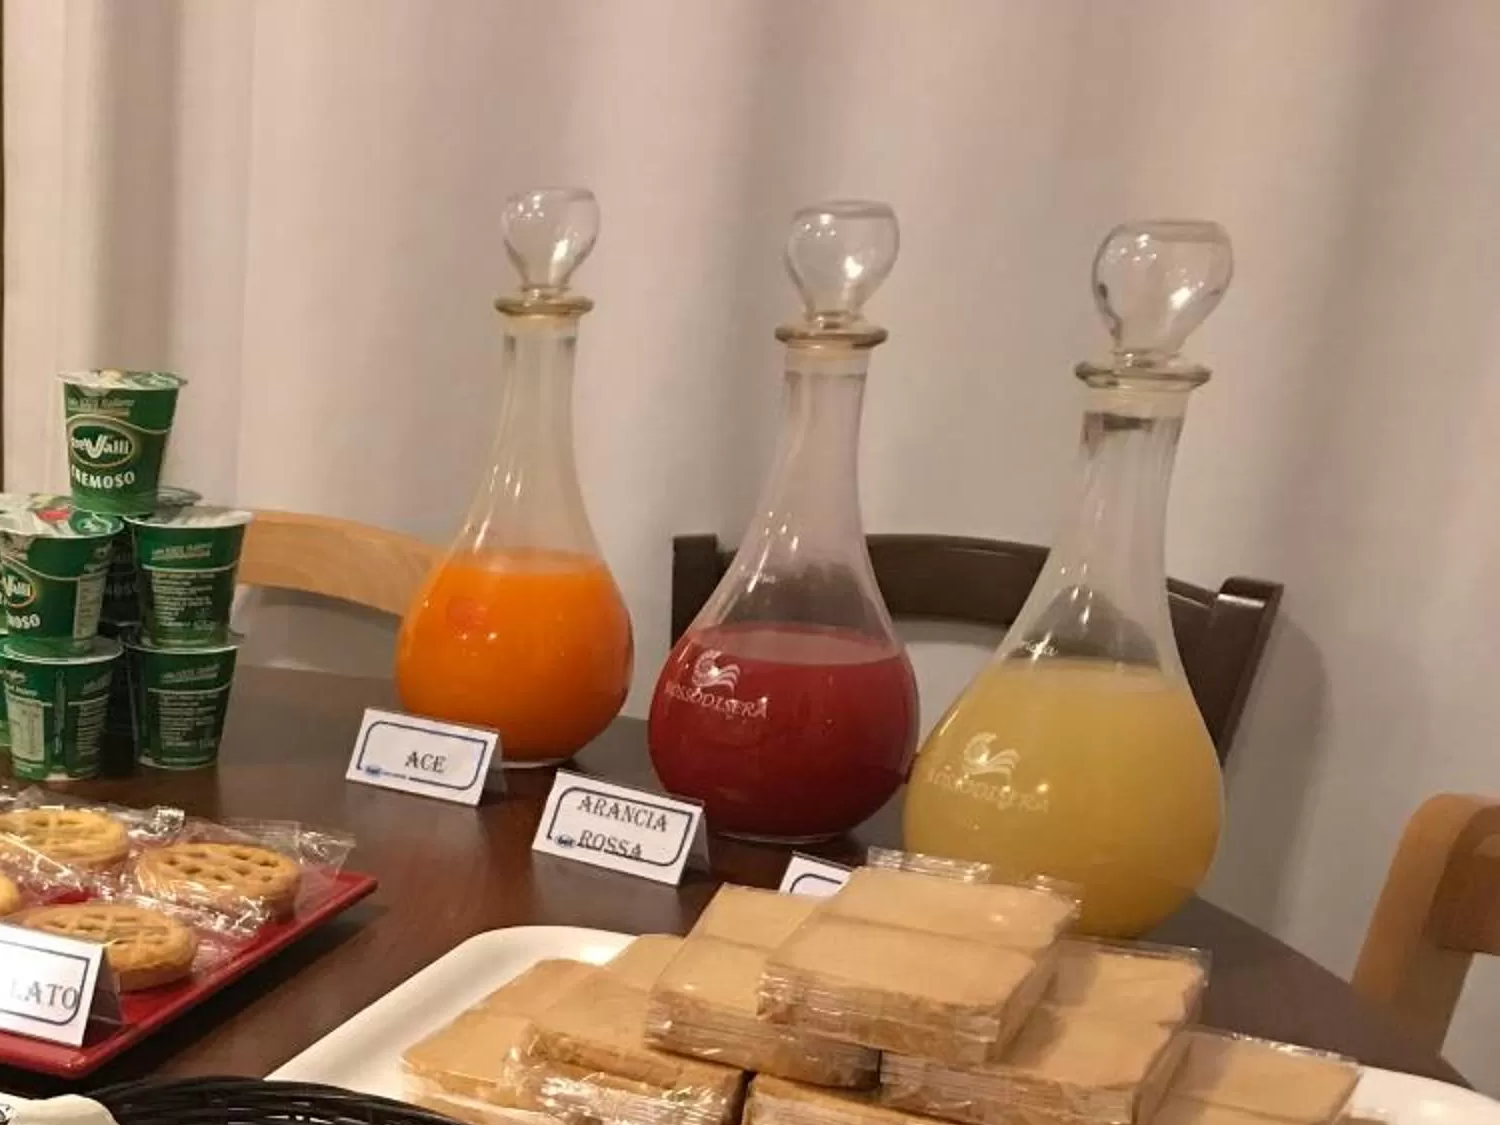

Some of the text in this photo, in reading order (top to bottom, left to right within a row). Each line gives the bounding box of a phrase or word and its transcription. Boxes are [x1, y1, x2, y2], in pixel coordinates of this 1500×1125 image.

[405, 751, 447, 773] ACE
[578, 795, 667, 832] ARANCIA
[577, 829, 642, 859] ROSSA
